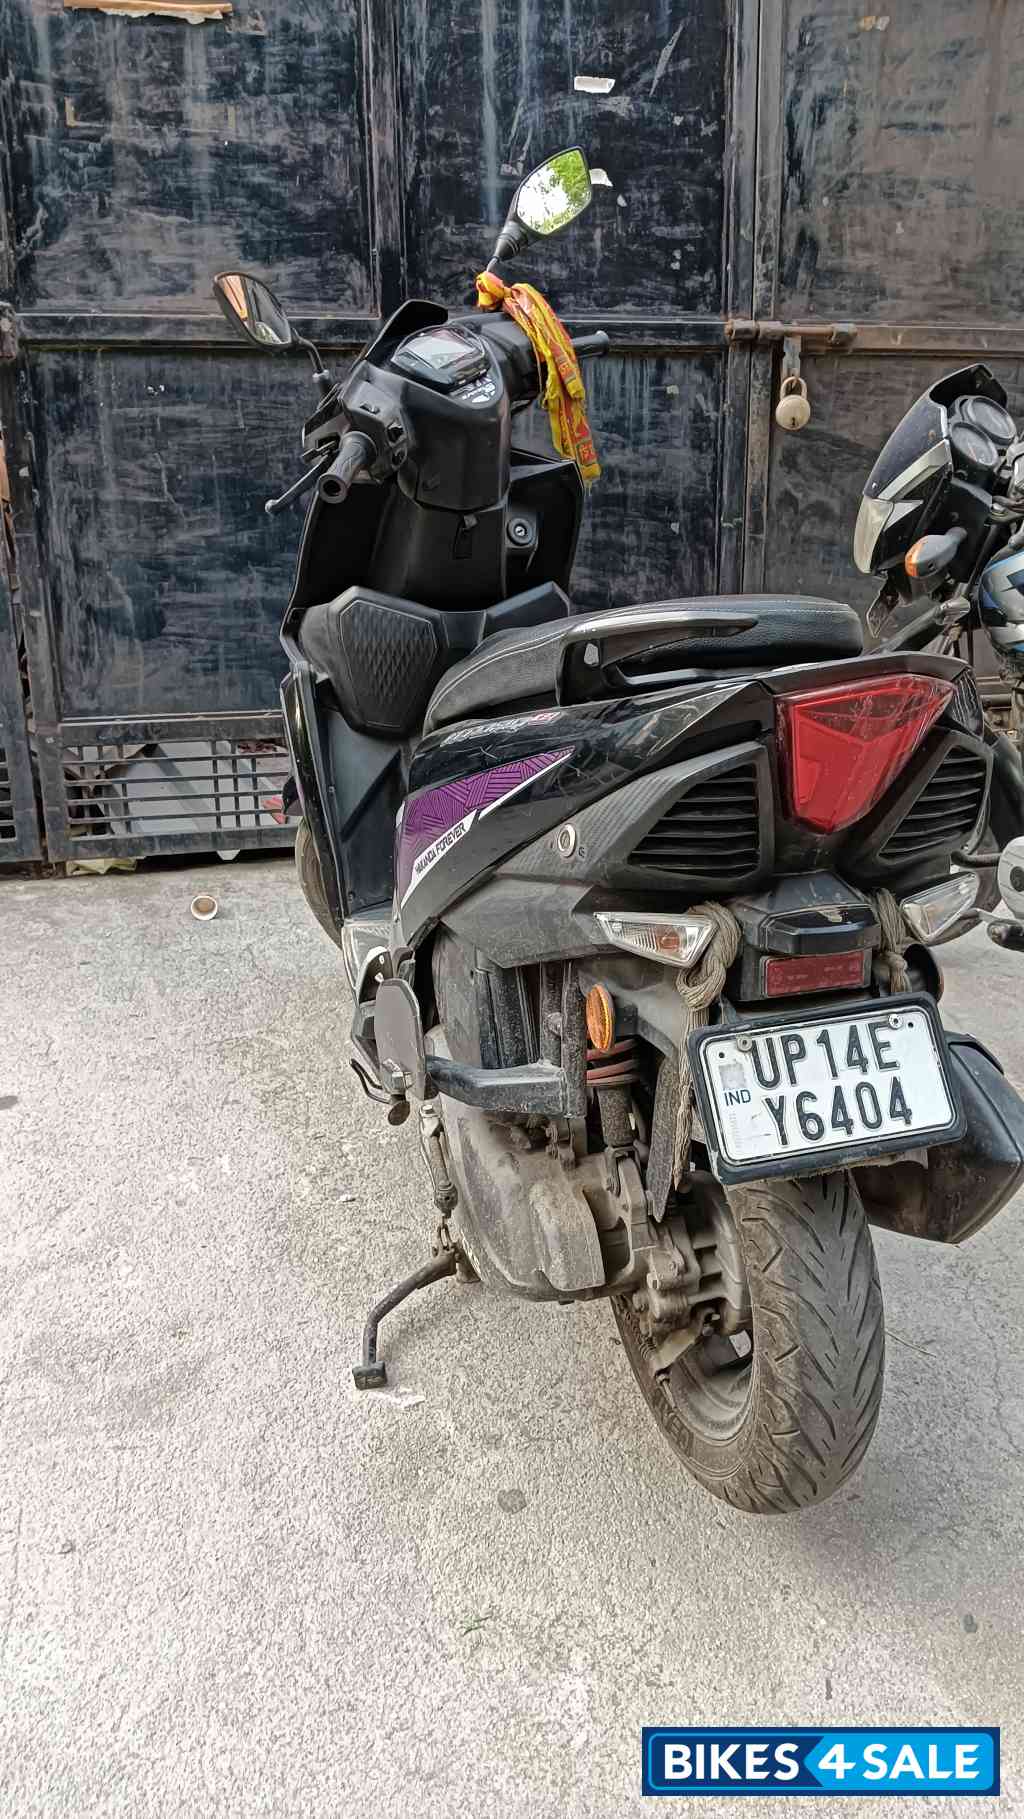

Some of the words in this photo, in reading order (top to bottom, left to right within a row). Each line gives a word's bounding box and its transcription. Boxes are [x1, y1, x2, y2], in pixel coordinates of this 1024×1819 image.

[415, 848, 437, 873] ANDA
[436, 822, 466, 855] FOREVER
[752, 1022, 899, 1089] UP14E
[724, 1089, 751, 1107] IND
[765, 1076, 913, 1145] Y6404
